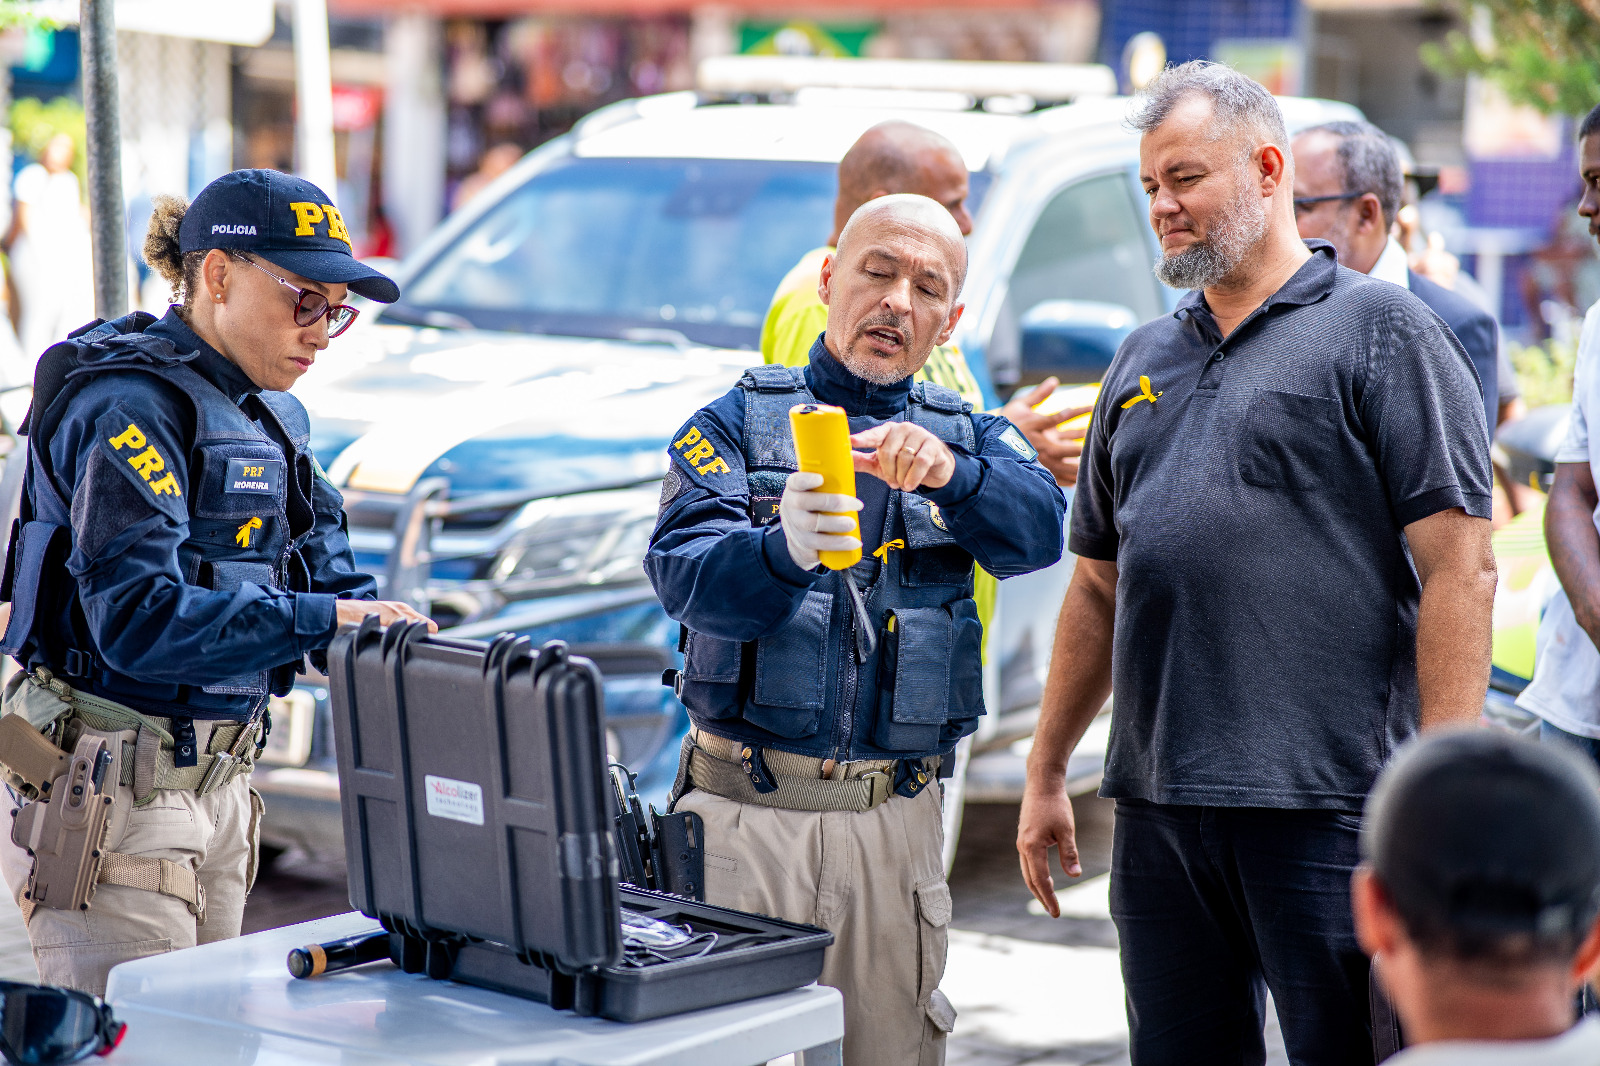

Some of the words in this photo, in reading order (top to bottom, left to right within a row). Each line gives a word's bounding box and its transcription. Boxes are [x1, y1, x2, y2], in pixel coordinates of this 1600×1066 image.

[290, 202, 353, 250] PR
[108, 423, 182, 497] PRF
[243, 466, 265, 477] PRF
[673, 425, 731, 476] PRF
[233, 481, 269, 490] MOREIRA
